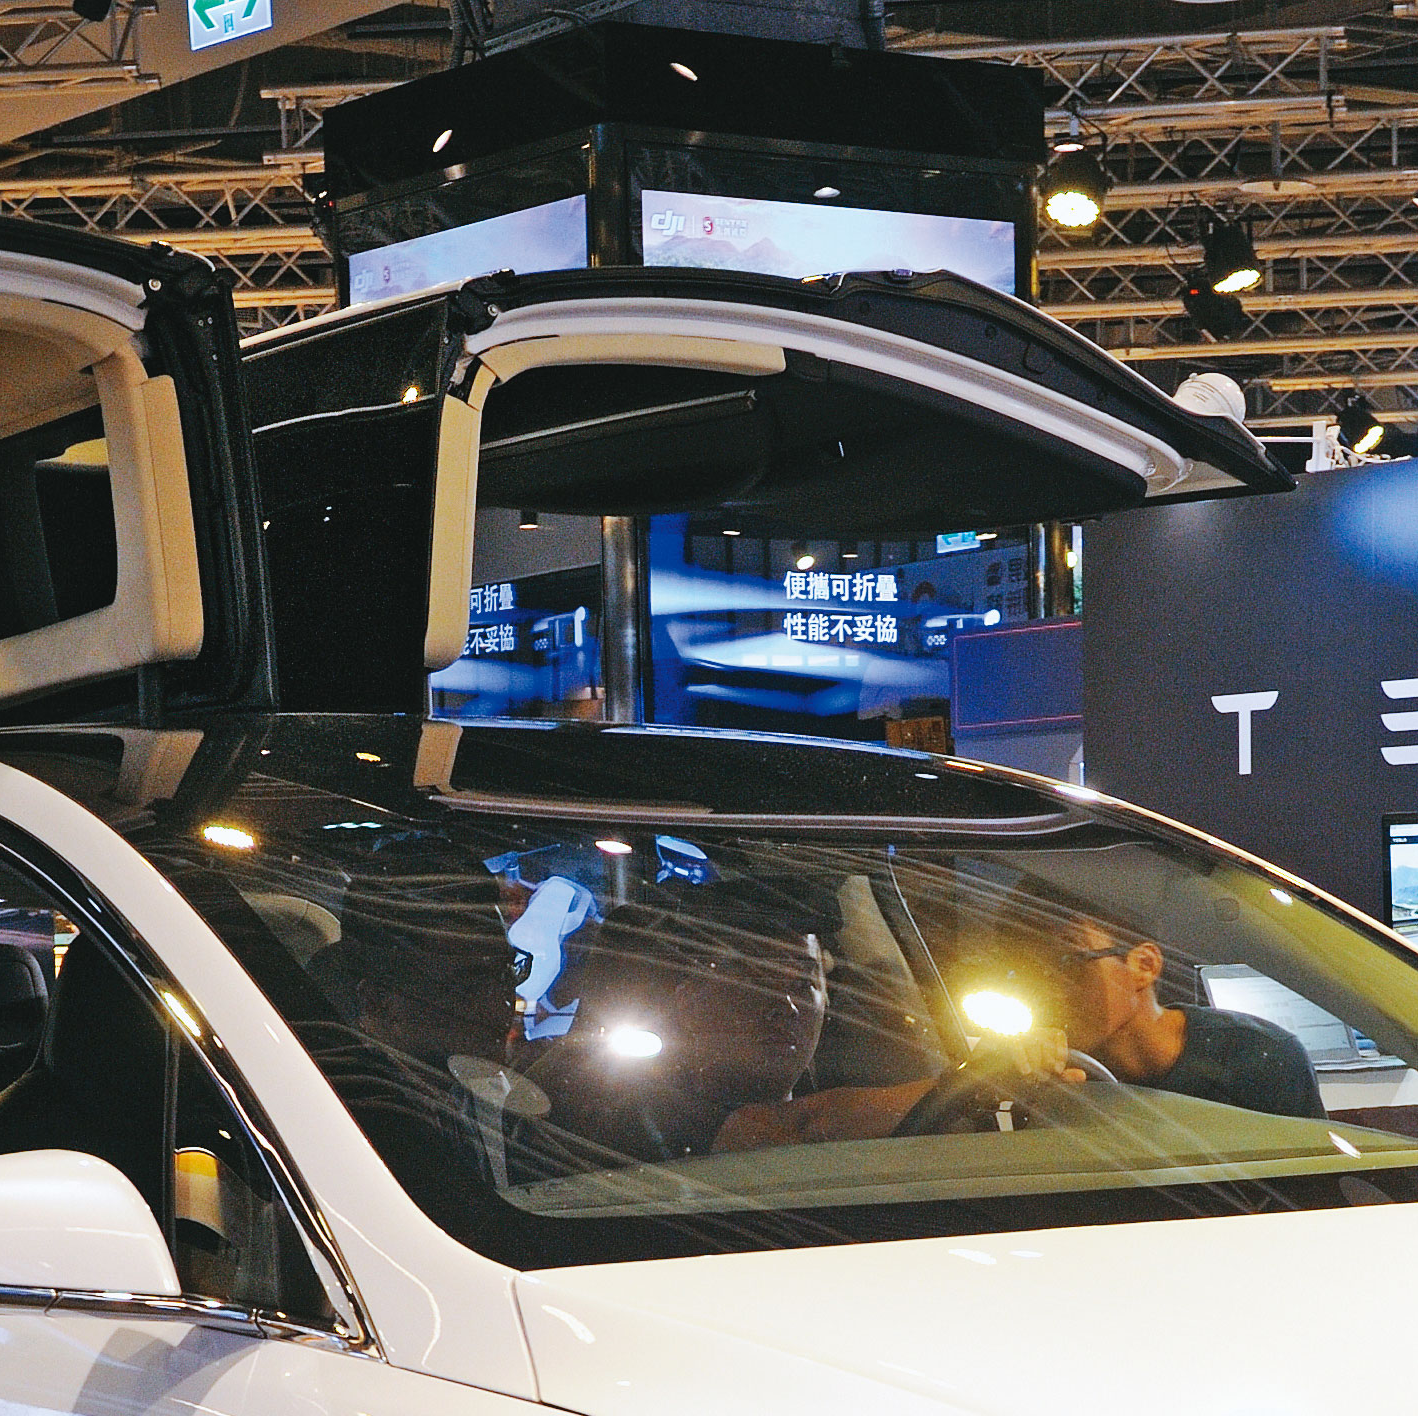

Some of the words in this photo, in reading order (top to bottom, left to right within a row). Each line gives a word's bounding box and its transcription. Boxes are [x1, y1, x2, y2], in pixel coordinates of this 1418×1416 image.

[783, 570, 898, 602] 便攜可折疊
[783, 612, 898, 643] 性能不妥協
